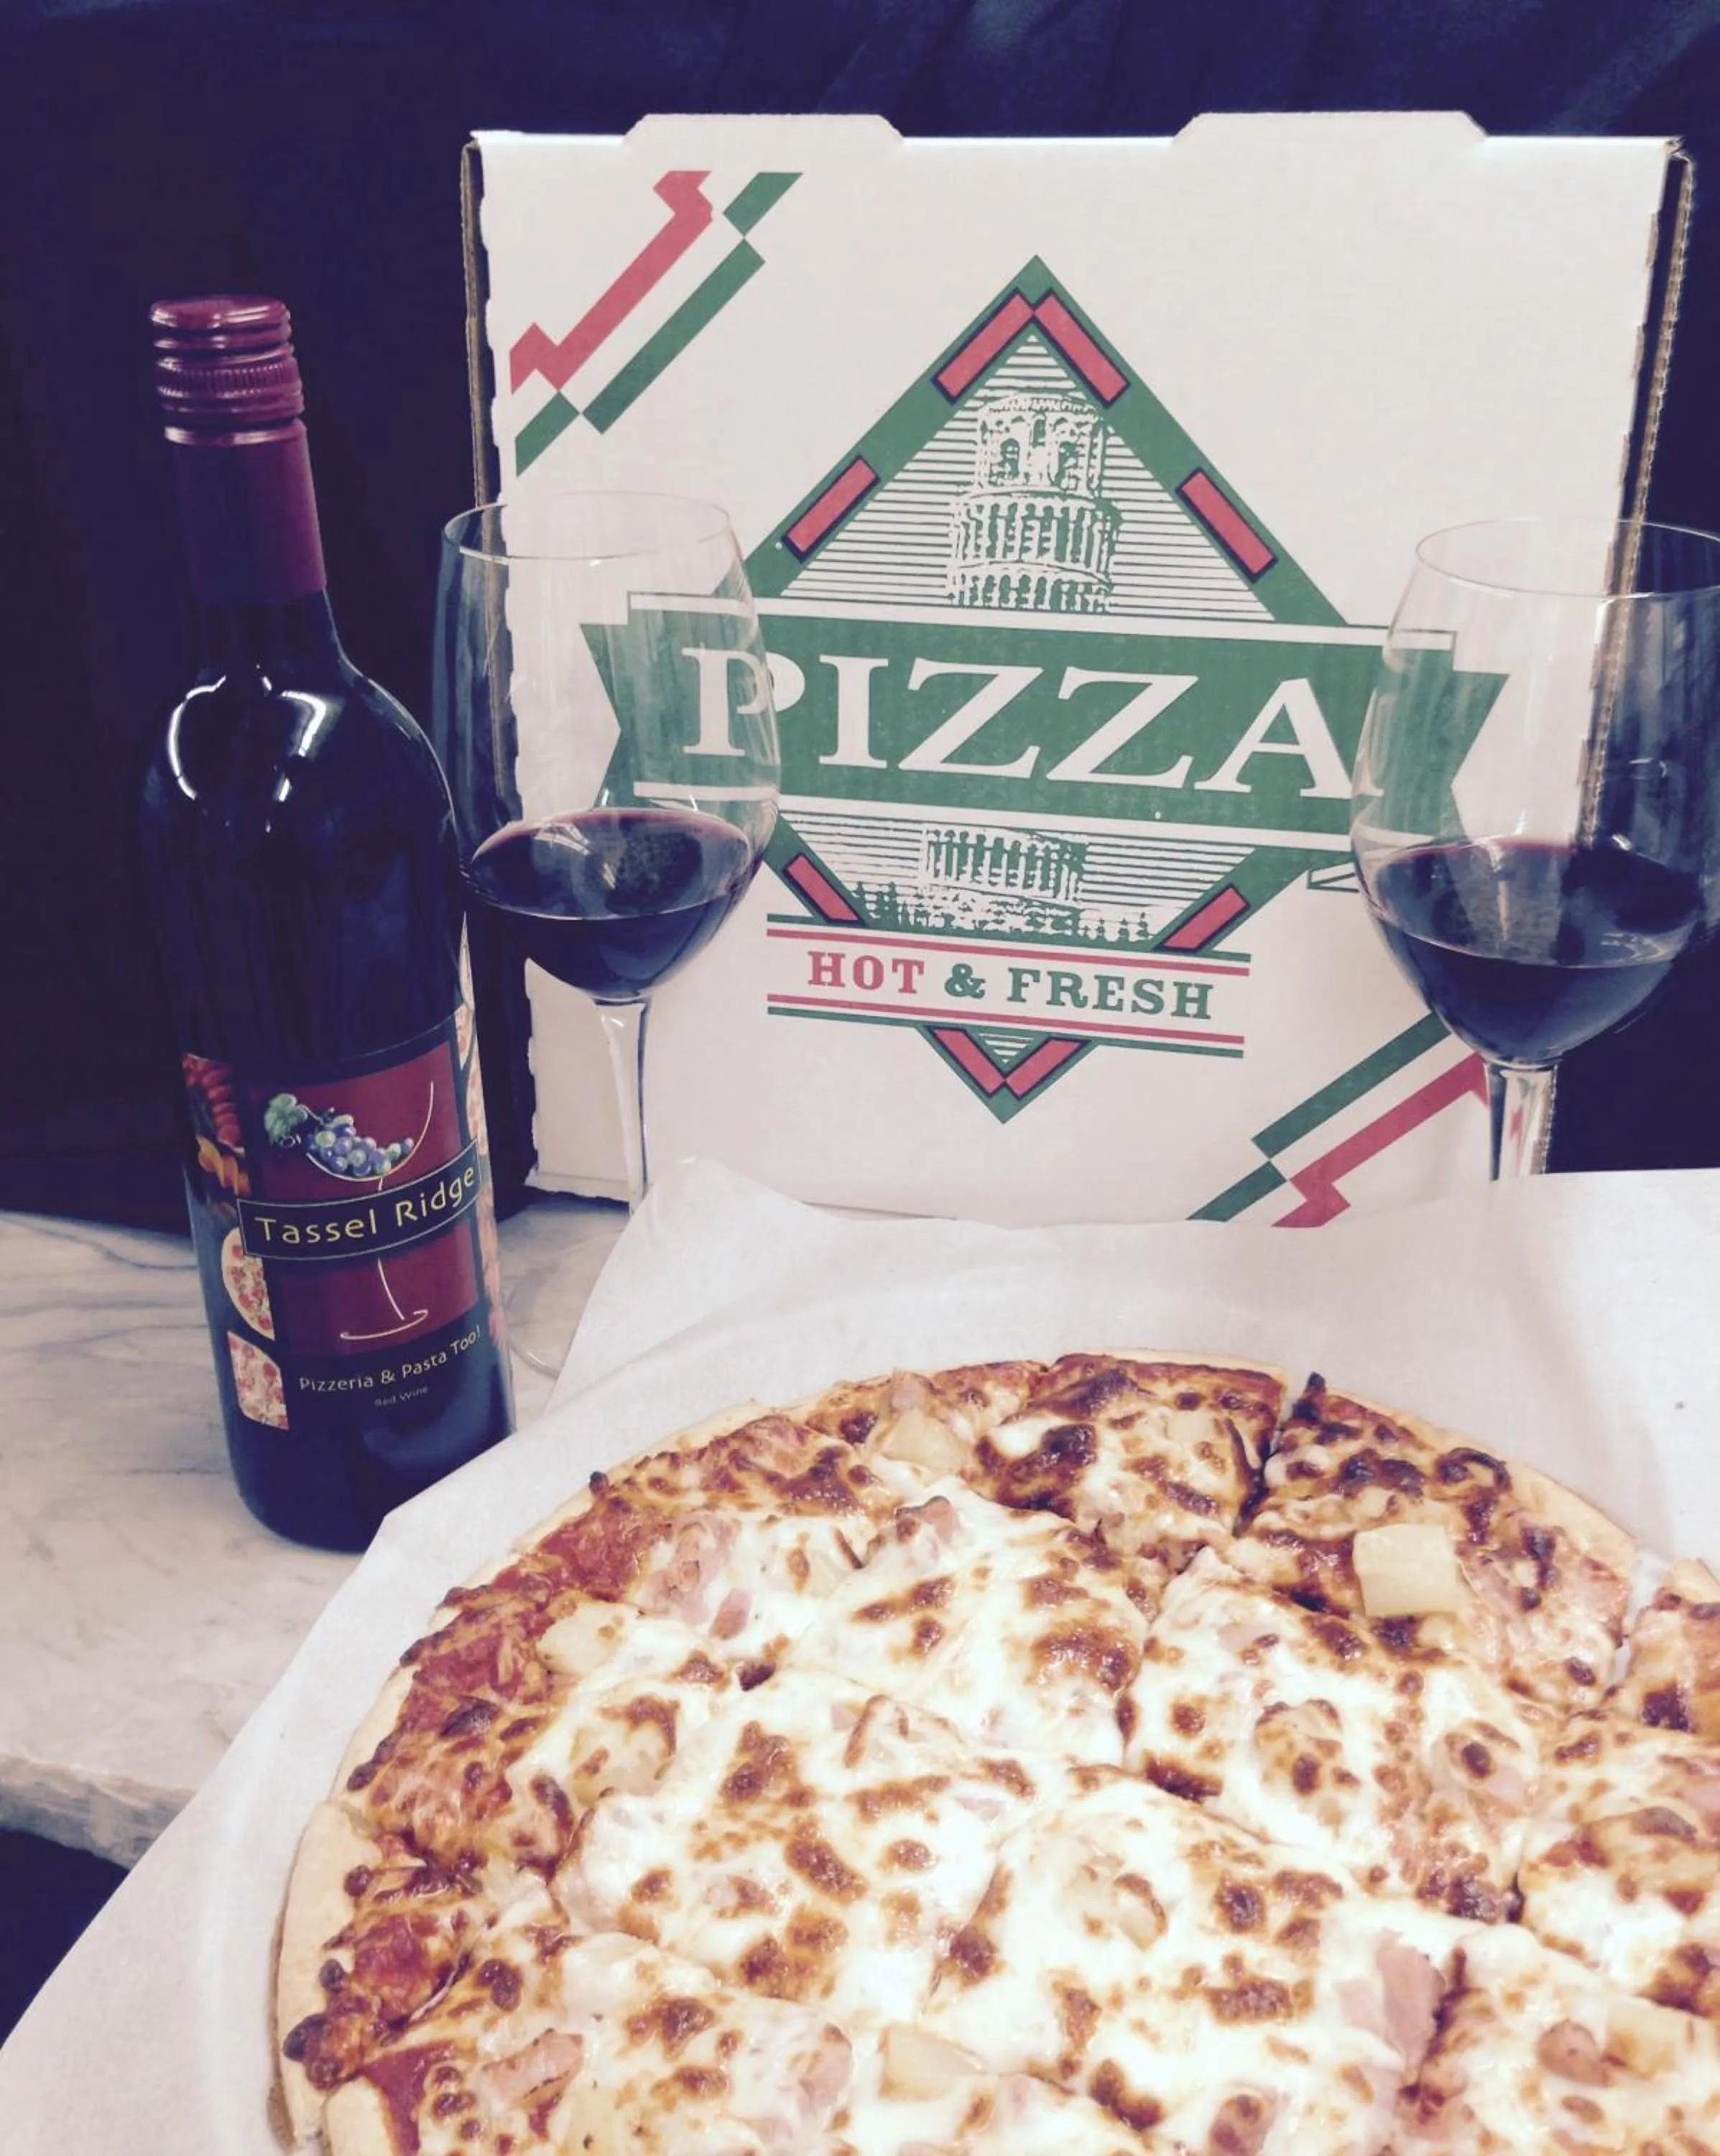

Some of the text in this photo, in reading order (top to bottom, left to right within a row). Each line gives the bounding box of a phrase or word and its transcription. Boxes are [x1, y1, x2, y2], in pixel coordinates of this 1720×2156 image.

[681, 648, 1384, 799] PIZZA
[808, 951, 1213, 1020] HOT & FRESH
[254, 1166, 474, 1244] Tassel Ridge
[299, 1324, 481, 1392] Pizzeria & Pasta Too!
[399, 1386, 428, 1401] Wine
